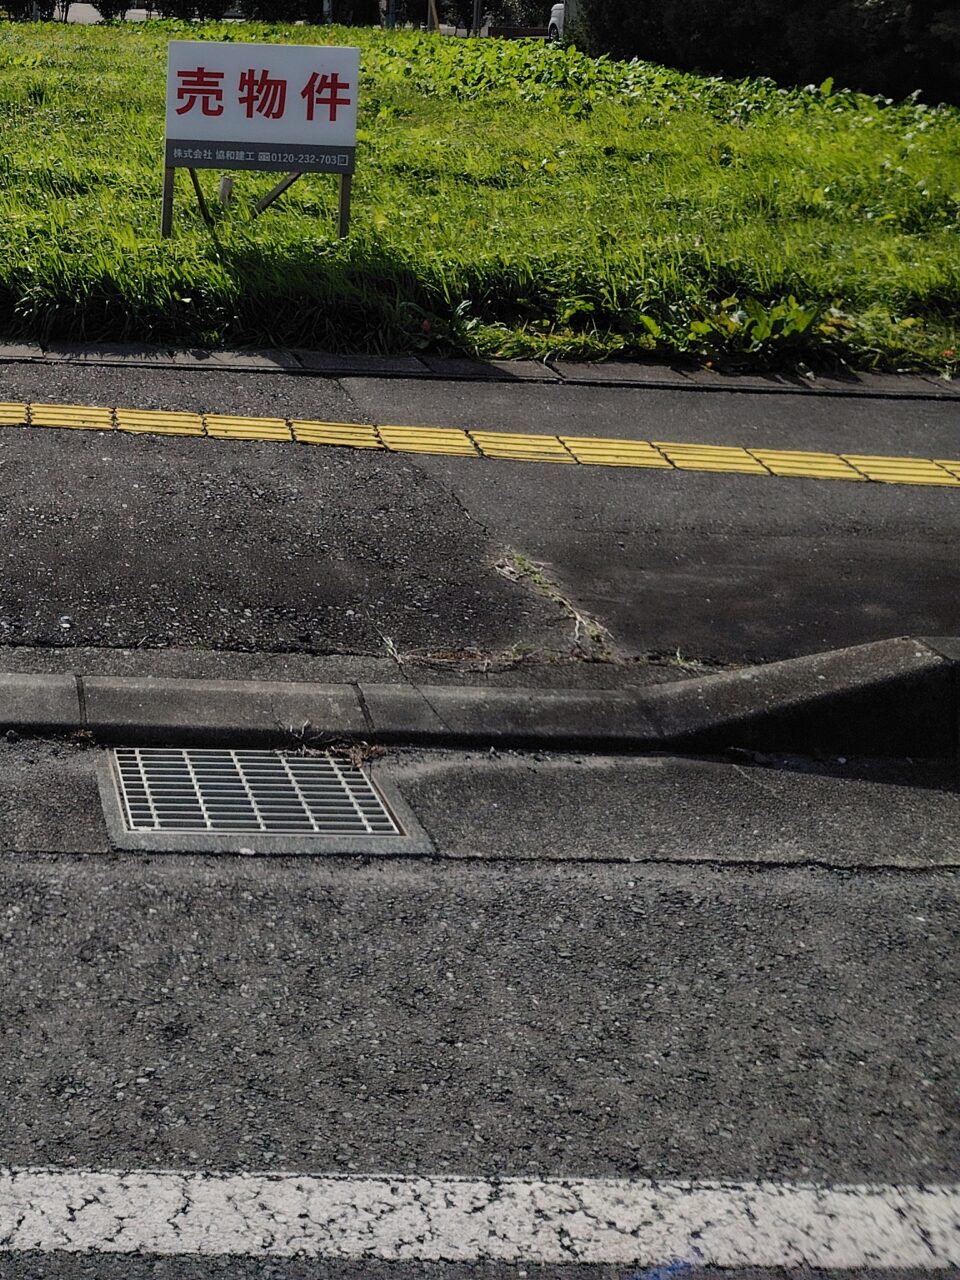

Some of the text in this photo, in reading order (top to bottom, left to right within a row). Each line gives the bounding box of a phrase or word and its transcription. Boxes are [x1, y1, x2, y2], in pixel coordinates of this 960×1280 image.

[175, 66, 351, 122] 売物件
[173, 148, 213, 160] 株式会社
[271, 152, 338, 166] 0120-232-703
